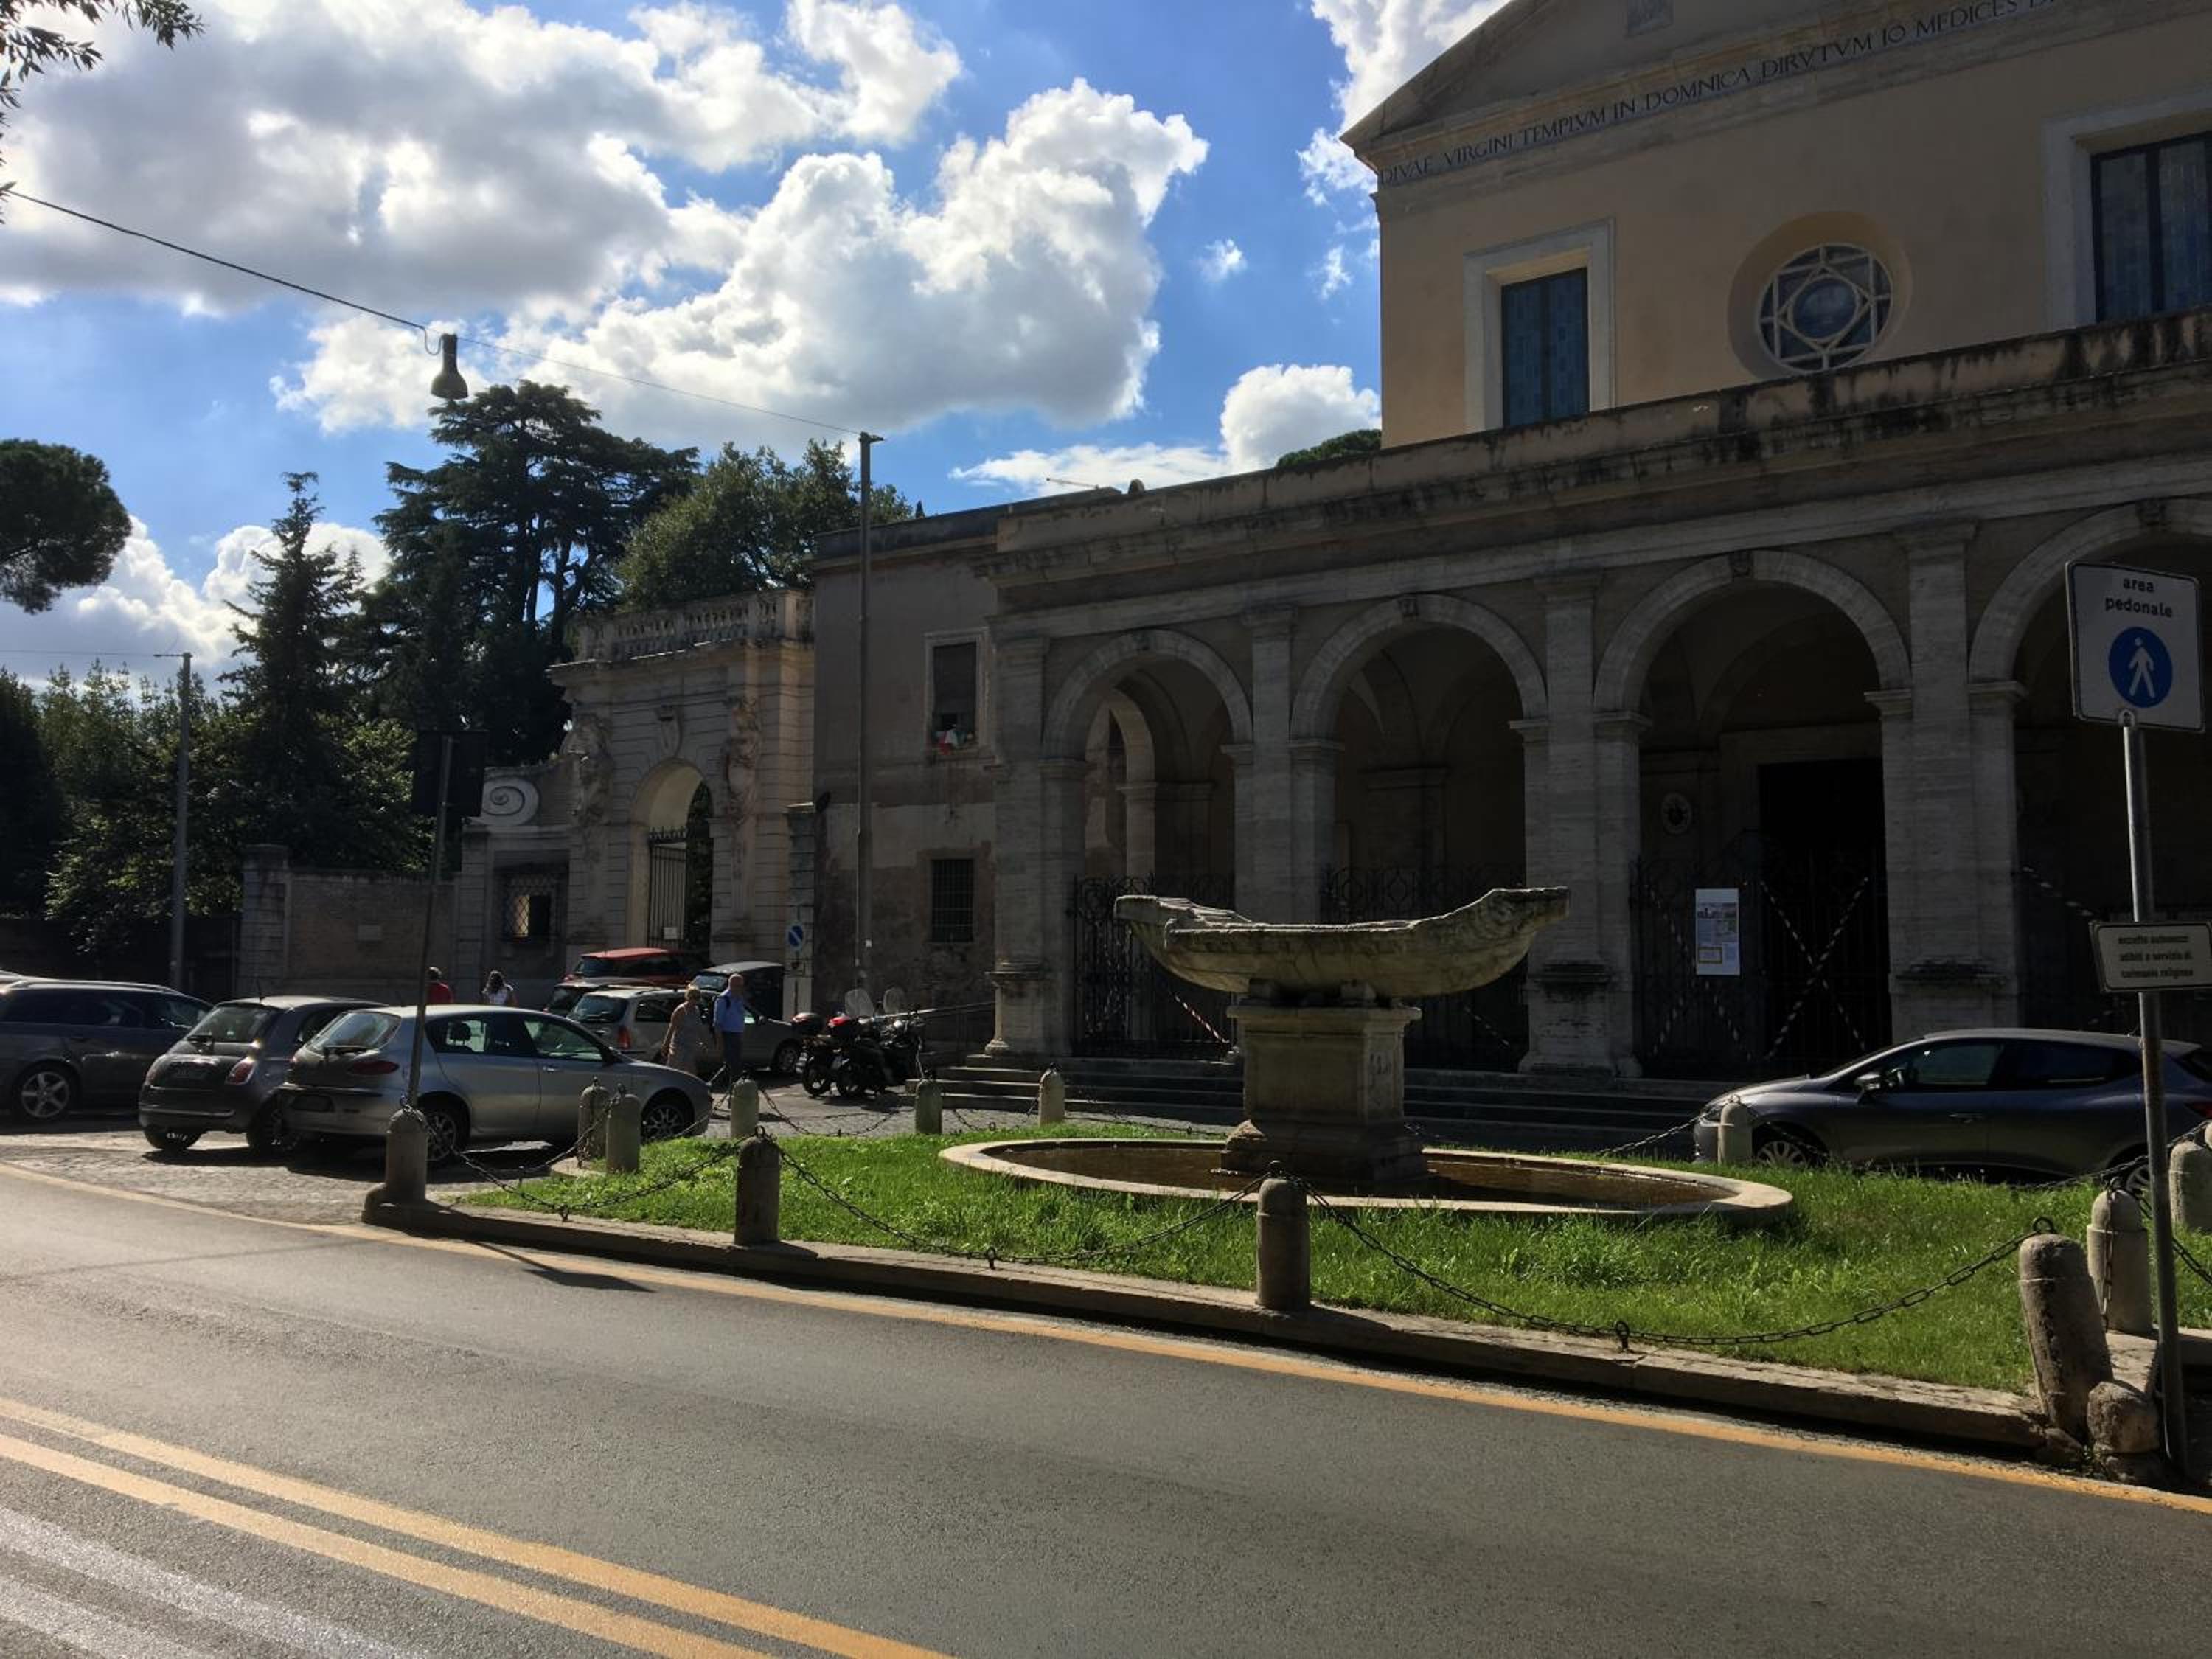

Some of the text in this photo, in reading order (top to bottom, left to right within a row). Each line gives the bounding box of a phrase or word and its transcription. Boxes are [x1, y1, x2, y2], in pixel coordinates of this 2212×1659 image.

[1443, 133, 1512, 166] VIRGINI
[1521, 105, 1606, 145] TEMPLVM
[1614, 100, 1636, 122] IN
[1646, 69, 1750, 108] DOMNICA
[1761, 34, 1872, 78] DIRVTVM
[2123, 578, 2154, 593] area
[2105, 597, 2172, 618] pedonale
